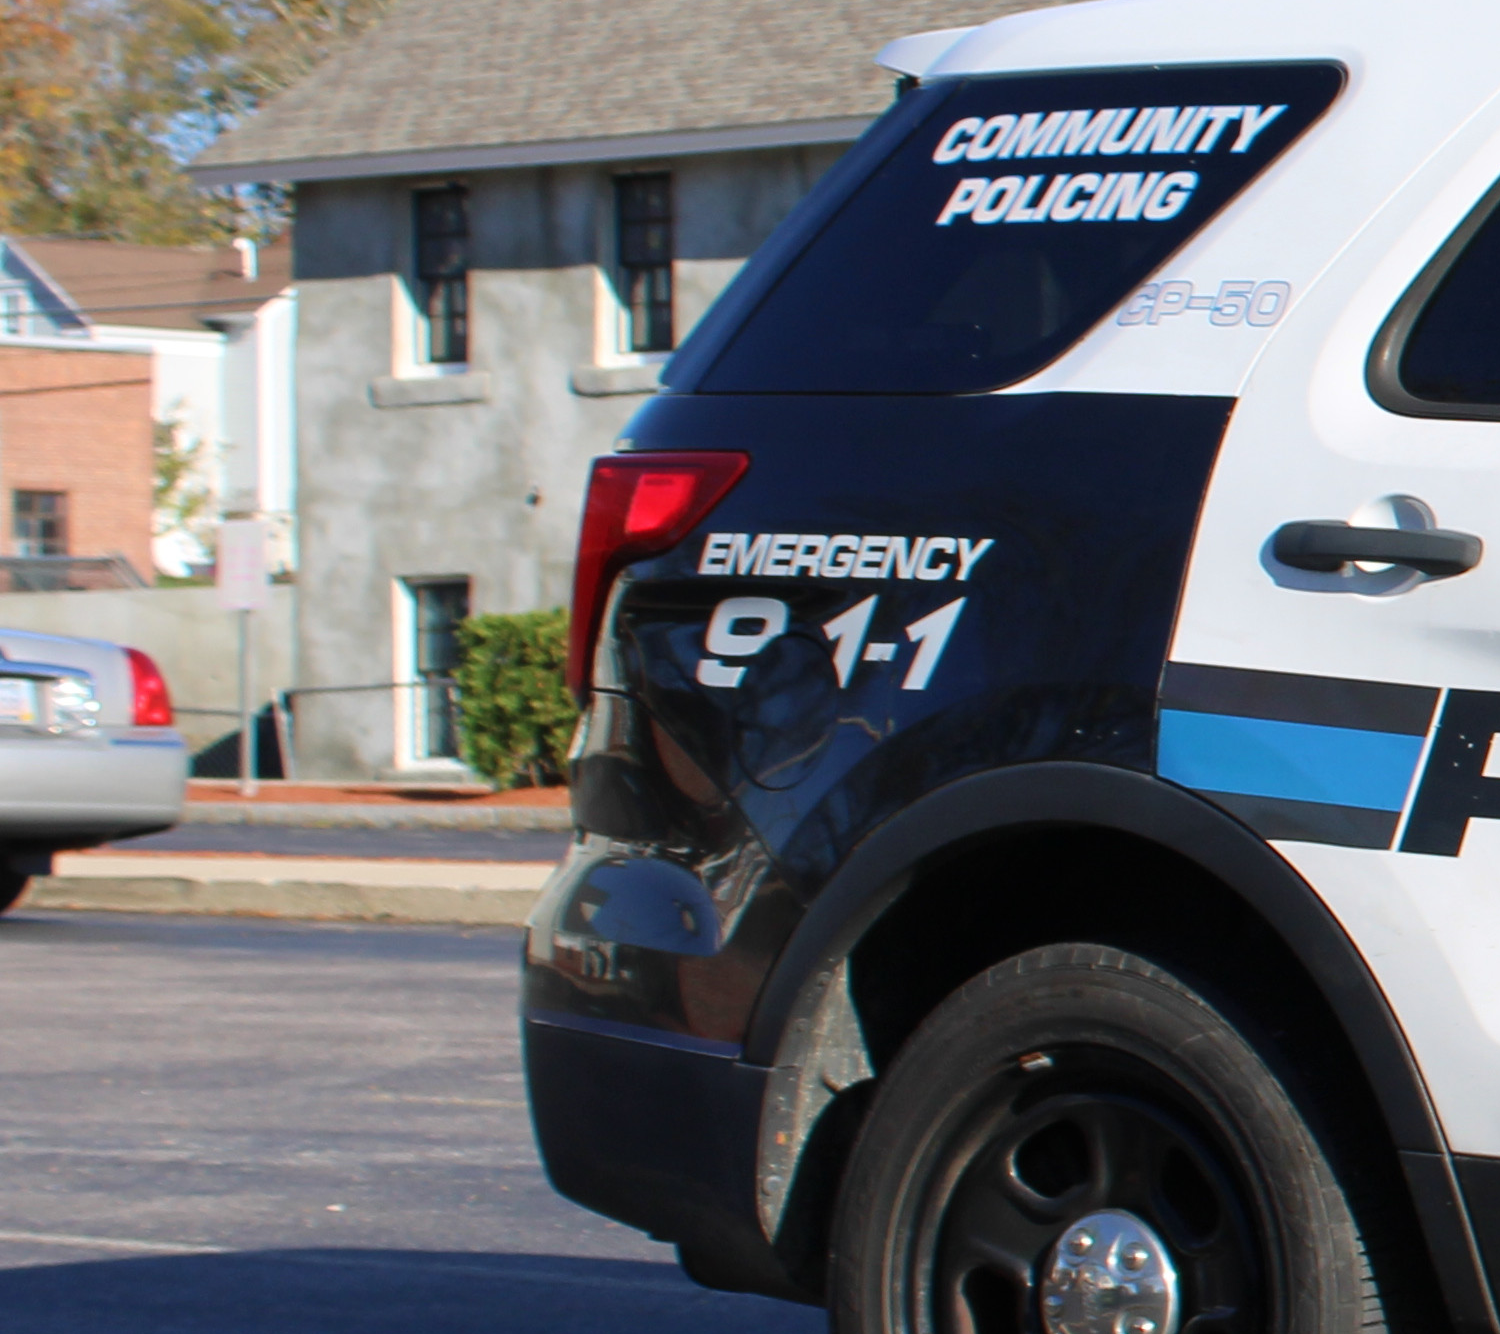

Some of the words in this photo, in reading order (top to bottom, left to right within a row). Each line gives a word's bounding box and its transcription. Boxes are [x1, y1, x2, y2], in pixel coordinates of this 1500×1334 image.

[932, 104, 1288, 164] COMMUNITY
[935, 172, 1198, 226] POLICING
[1116, 280, 1291, 327] CP-50
[698, 533, 994, 580] EMERGENCY
